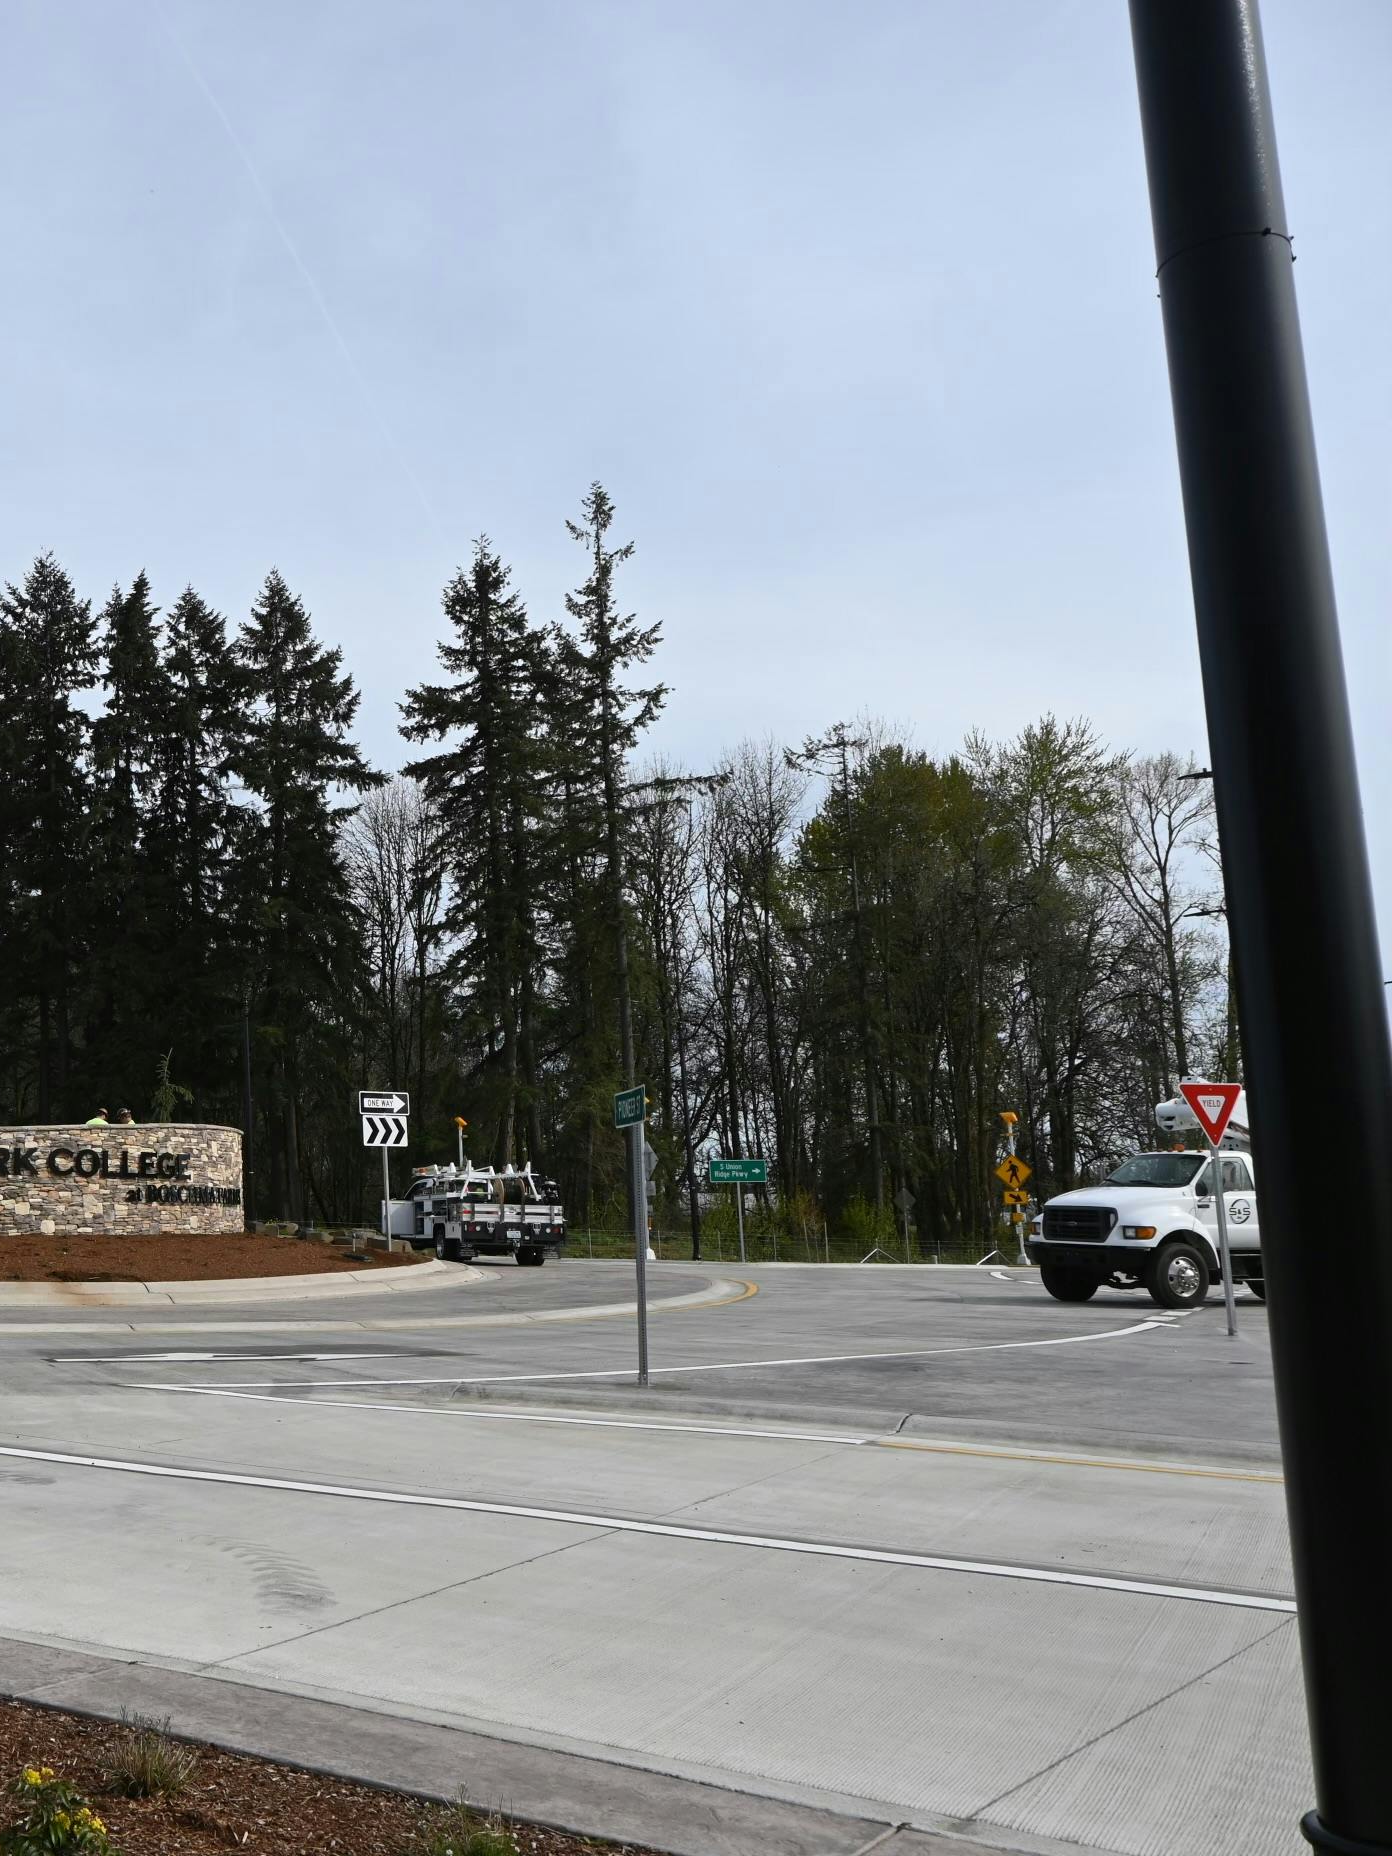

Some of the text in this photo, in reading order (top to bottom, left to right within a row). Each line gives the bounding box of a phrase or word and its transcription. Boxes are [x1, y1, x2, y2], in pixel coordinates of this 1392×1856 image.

[368, 1099, 380, 1107] ONE
[48, 1147, 192, 1180] COLLEGE
[731, 1171, 749, 1179] Pkwy
